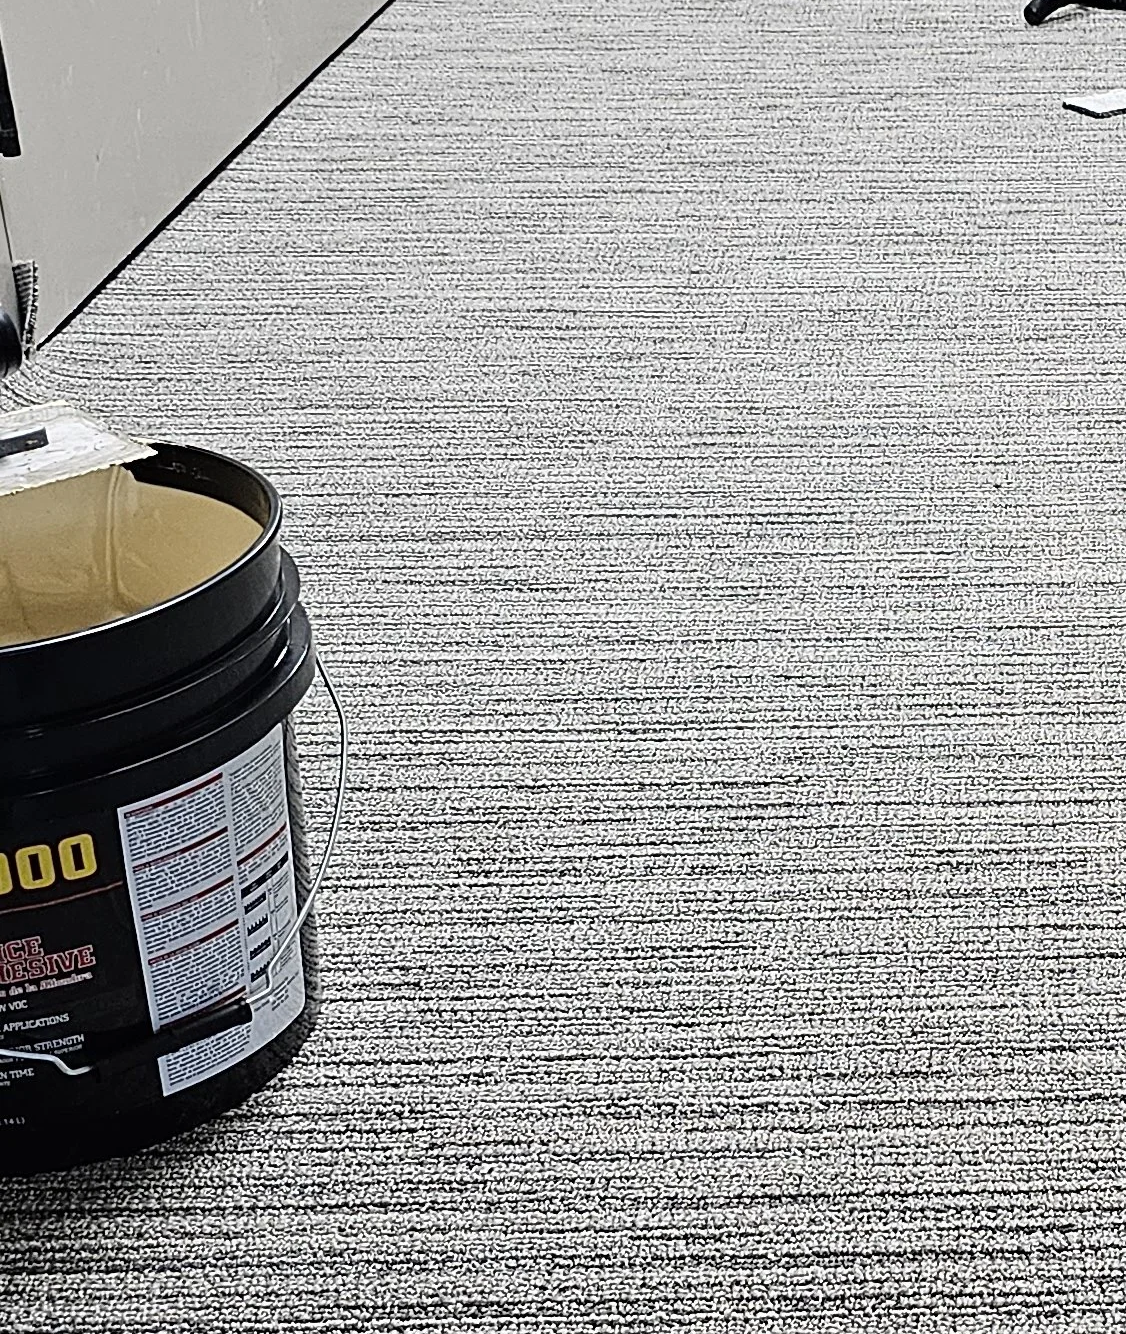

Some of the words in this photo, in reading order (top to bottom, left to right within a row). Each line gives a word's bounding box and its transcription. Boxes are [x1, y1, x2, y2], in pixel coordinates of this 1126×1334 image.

[8, 999, 28, 1011] VOC
[3, 1013, 70, 1032] APPLICATIONS
[33, 1033, 85, 1051] STRENGTH
[9, 1068, 35, 1079] TIME
